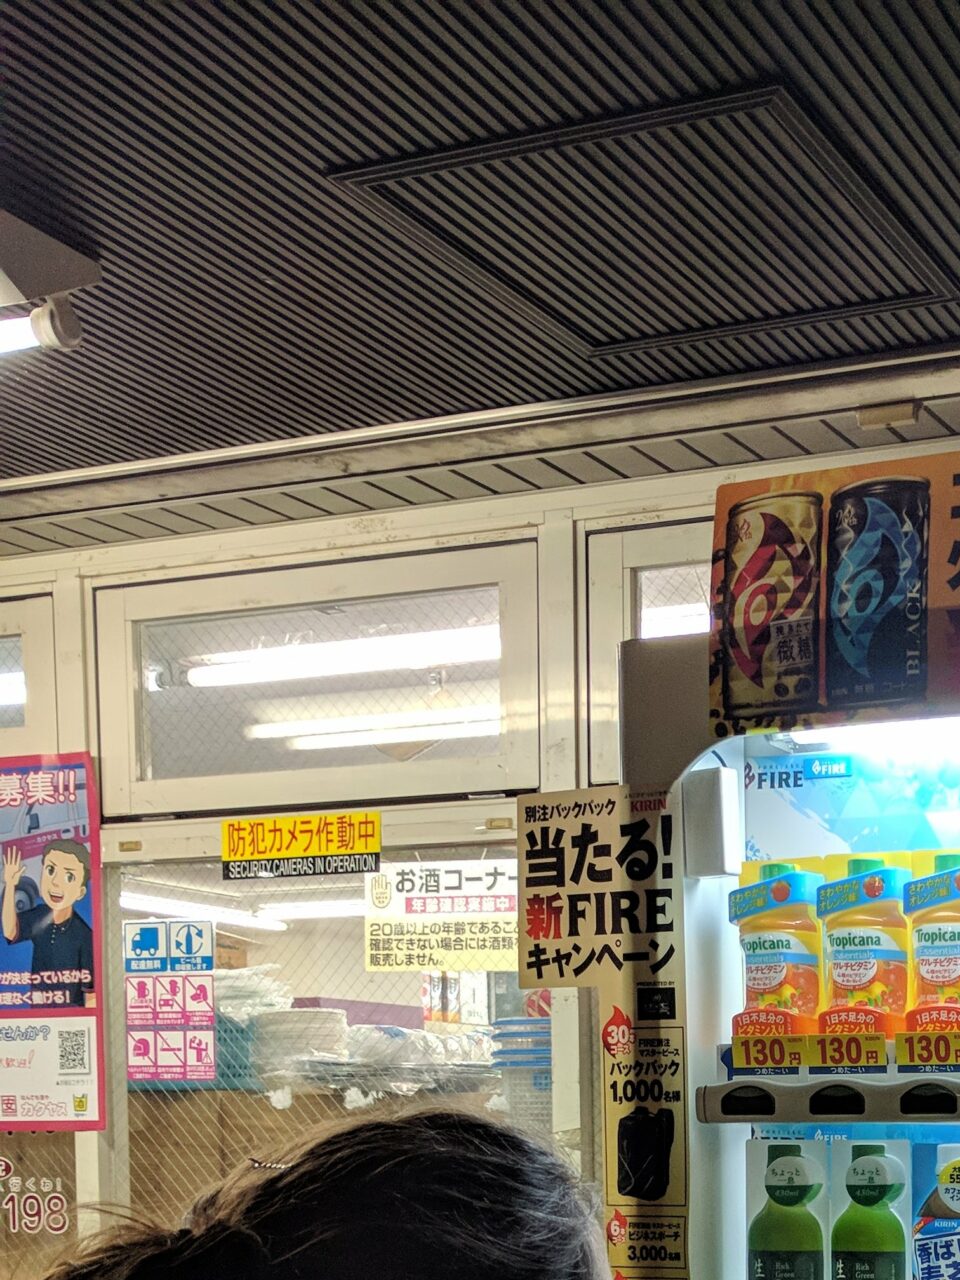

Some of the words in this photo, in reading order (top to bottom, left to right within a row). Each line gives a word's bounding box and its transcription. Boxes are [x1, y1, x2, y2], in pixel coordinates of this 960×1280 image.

[906, 580, 923, 677] BLACK
[757, 771, 804, 790] FIRE
[821, 763, 846, 775] FIRE
[525, 799, 617, 824] 別注バックパック
[631, 798, 667, 812] KIRIN
[226, 814, 376, 858] 防犯カメラ作動中
[525, 814, 674, 888] 当たる!
[229, 860, 271, 879] SECURITY
[272, 859, 313, 877] CAMERAS
[315, 858, 324, 873] IN
[326, 855, 376, 873] OPERATION
[525, 888, 674, 941] 新FIRE
[369, 952, 446, 968] 販売しません。
[526, 938, 676, 980] キャンペーン
[740, 1038, 802, 1066] 130円
[816, 1037, 878, 1064] 130円
[609, 1079, 681, 1105] 1,000名様
[3, 1193, 69, 1234] 198
